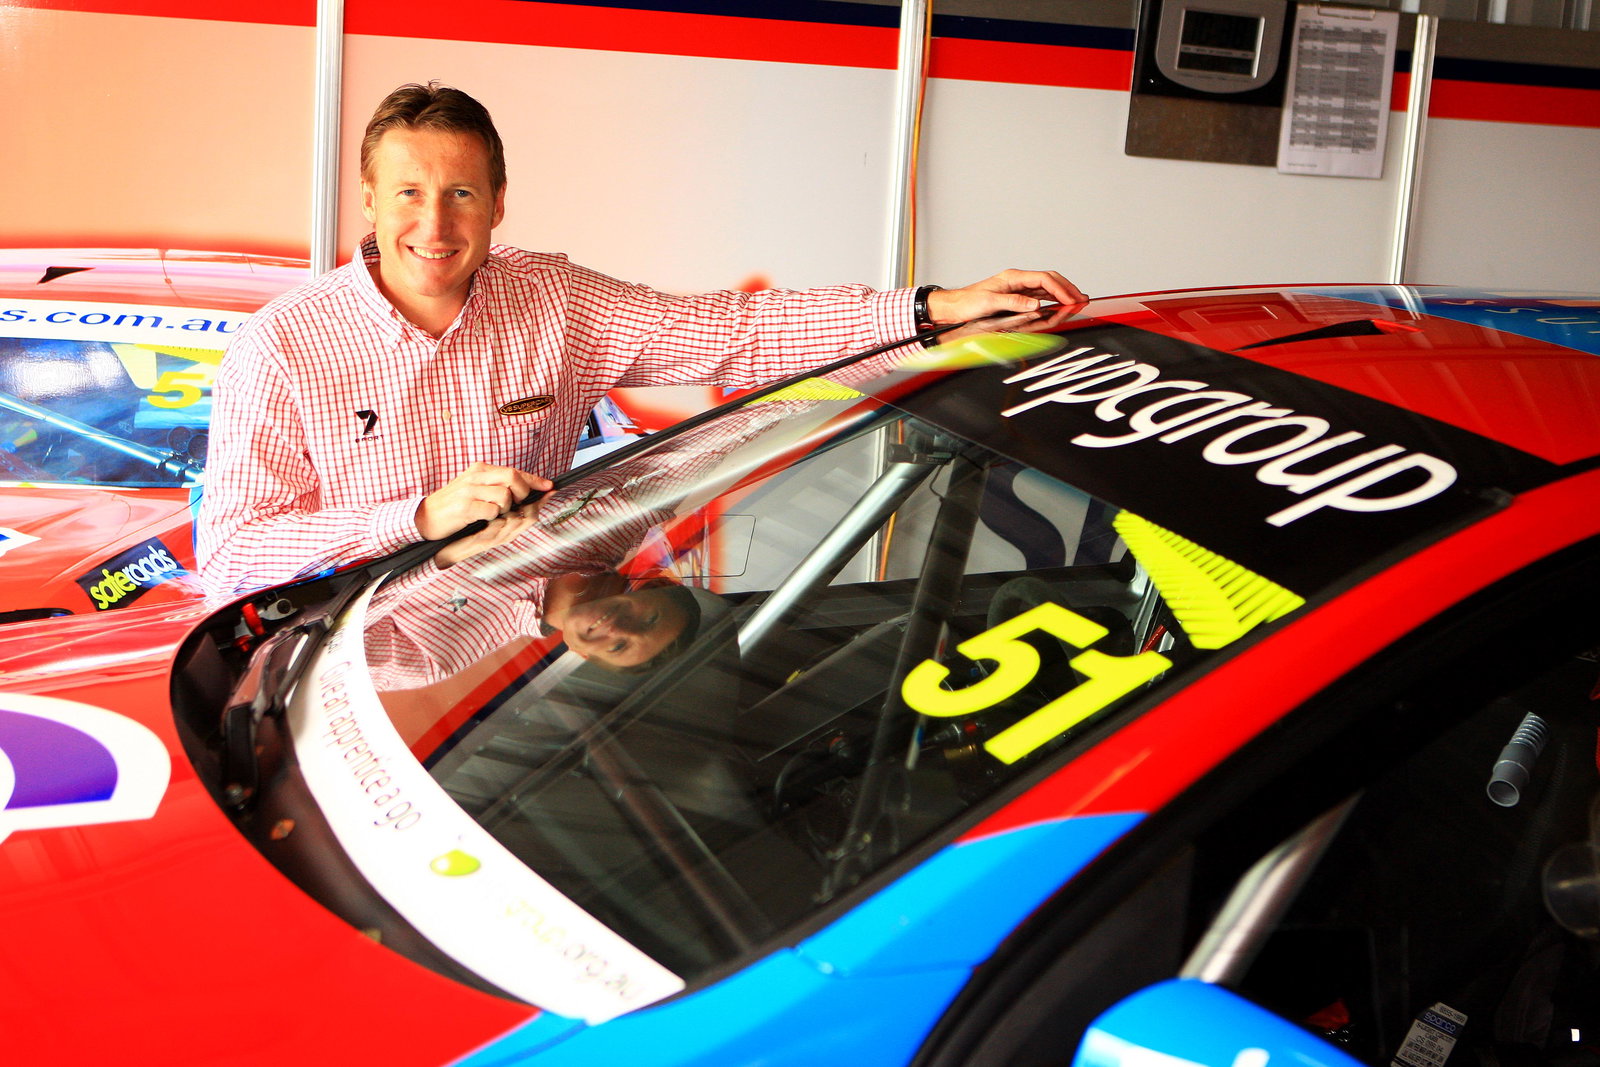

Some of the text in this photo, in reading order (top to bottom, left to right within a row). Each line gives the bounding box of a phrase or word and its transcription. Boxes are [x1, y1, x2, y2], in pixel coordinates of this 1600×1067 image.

[1001, 346, 1458, 527] wpcgroup
[901, 601, 1173, 766] 51
[322, 711, 392, 795] apprentice
[374, 787, 400, 807] a
[374, 801, 422, 831] go
